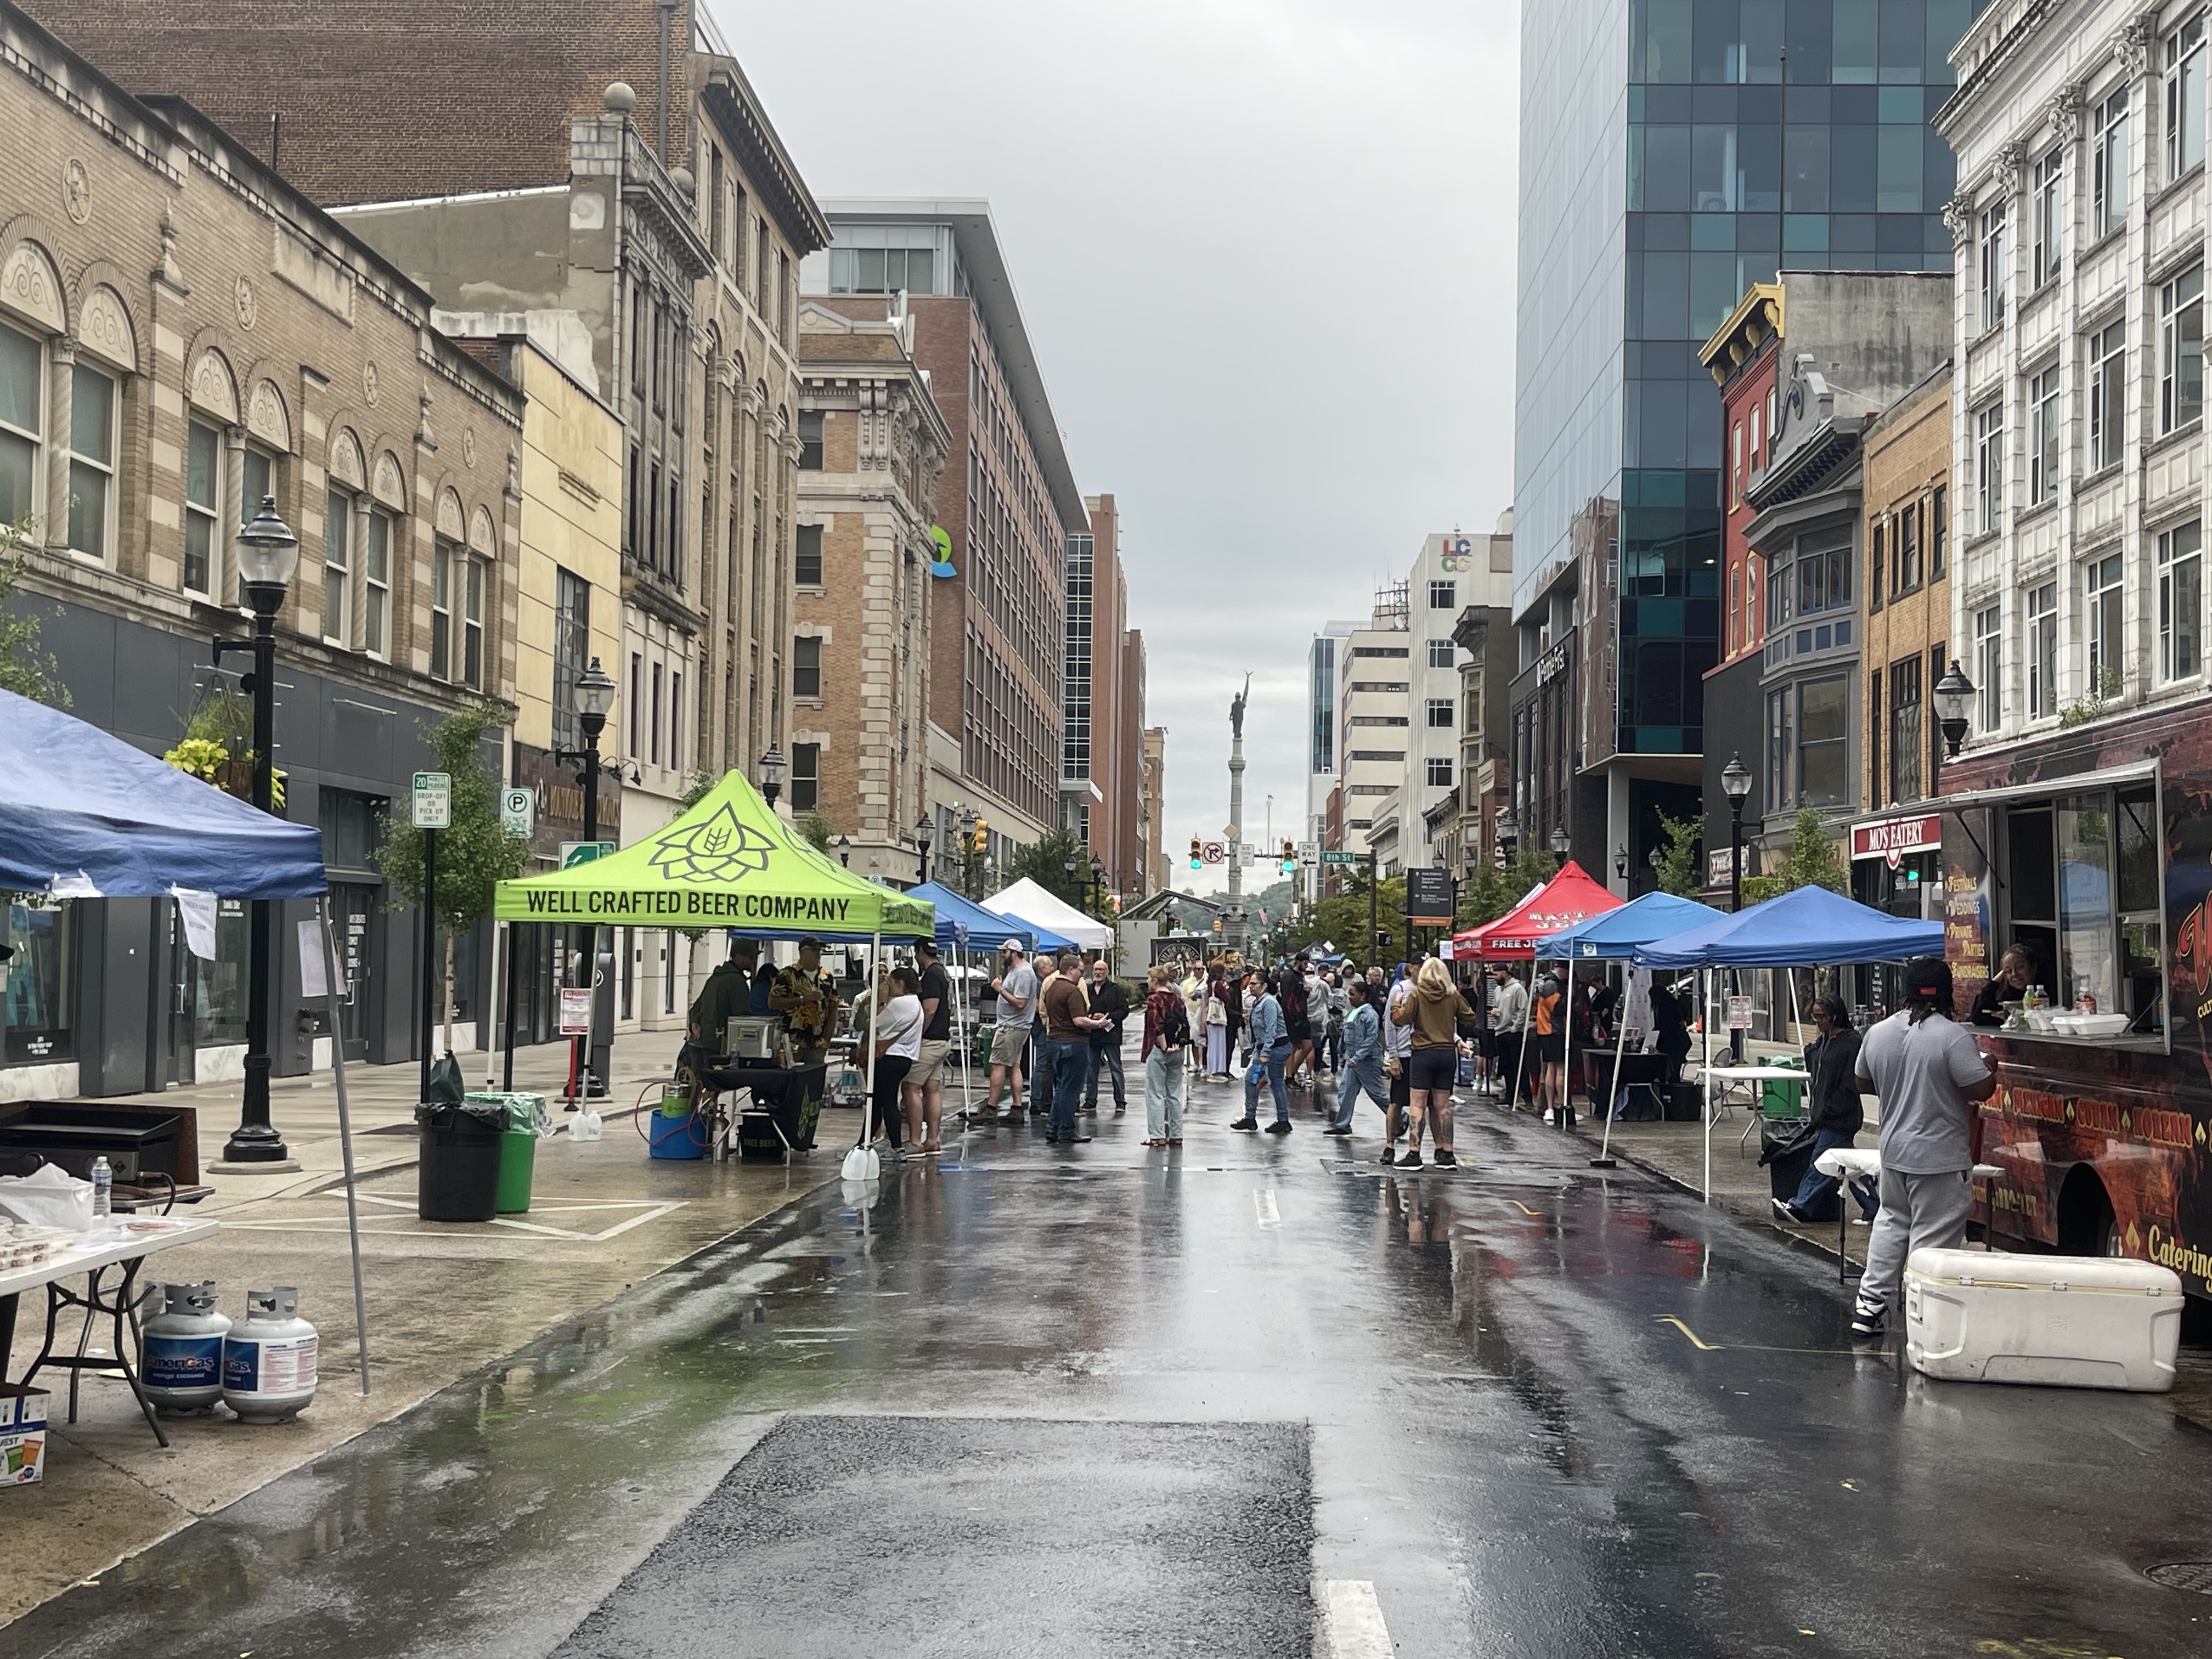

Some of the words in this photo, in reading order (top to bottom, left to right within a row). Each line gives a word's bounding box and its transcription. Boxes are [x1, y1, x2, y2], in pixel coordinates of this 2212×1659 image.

[416, 777, 426, 787] 20
[1869, 826, 1888, 850] MO'S
[1891, 820, 1924, 848] EATERY
[1341, 853, 1351, 861] St
[1948, 876, 1977, 892] FESTIVALS
[527, 890, 583, 913] WELL
[589, 891, 681, 913] CRAFTED
[688, 891, 740, 916] BEER
[746, 895, 850, 921] COMPANY
[1949, 897, 1980, 917] WEDDINGS
[1949, 922, 1972, 939] PRIVATE
[1492, 939, 1521, 948] FREE
[1962, 940, 1985, 957] PARTIES
[1952, 962, 1989, 978] FUNDRAISERS
[2013, 1087, 2065, 1124] MEXICAN
[2076, 1098, 2120, 1133] CUBAN
[2132, 1107, 2192, 1148] KOREAN
[759, 1138, 777, 1147] BEER
[146, 1356, 215, 1370] AmeriGas
